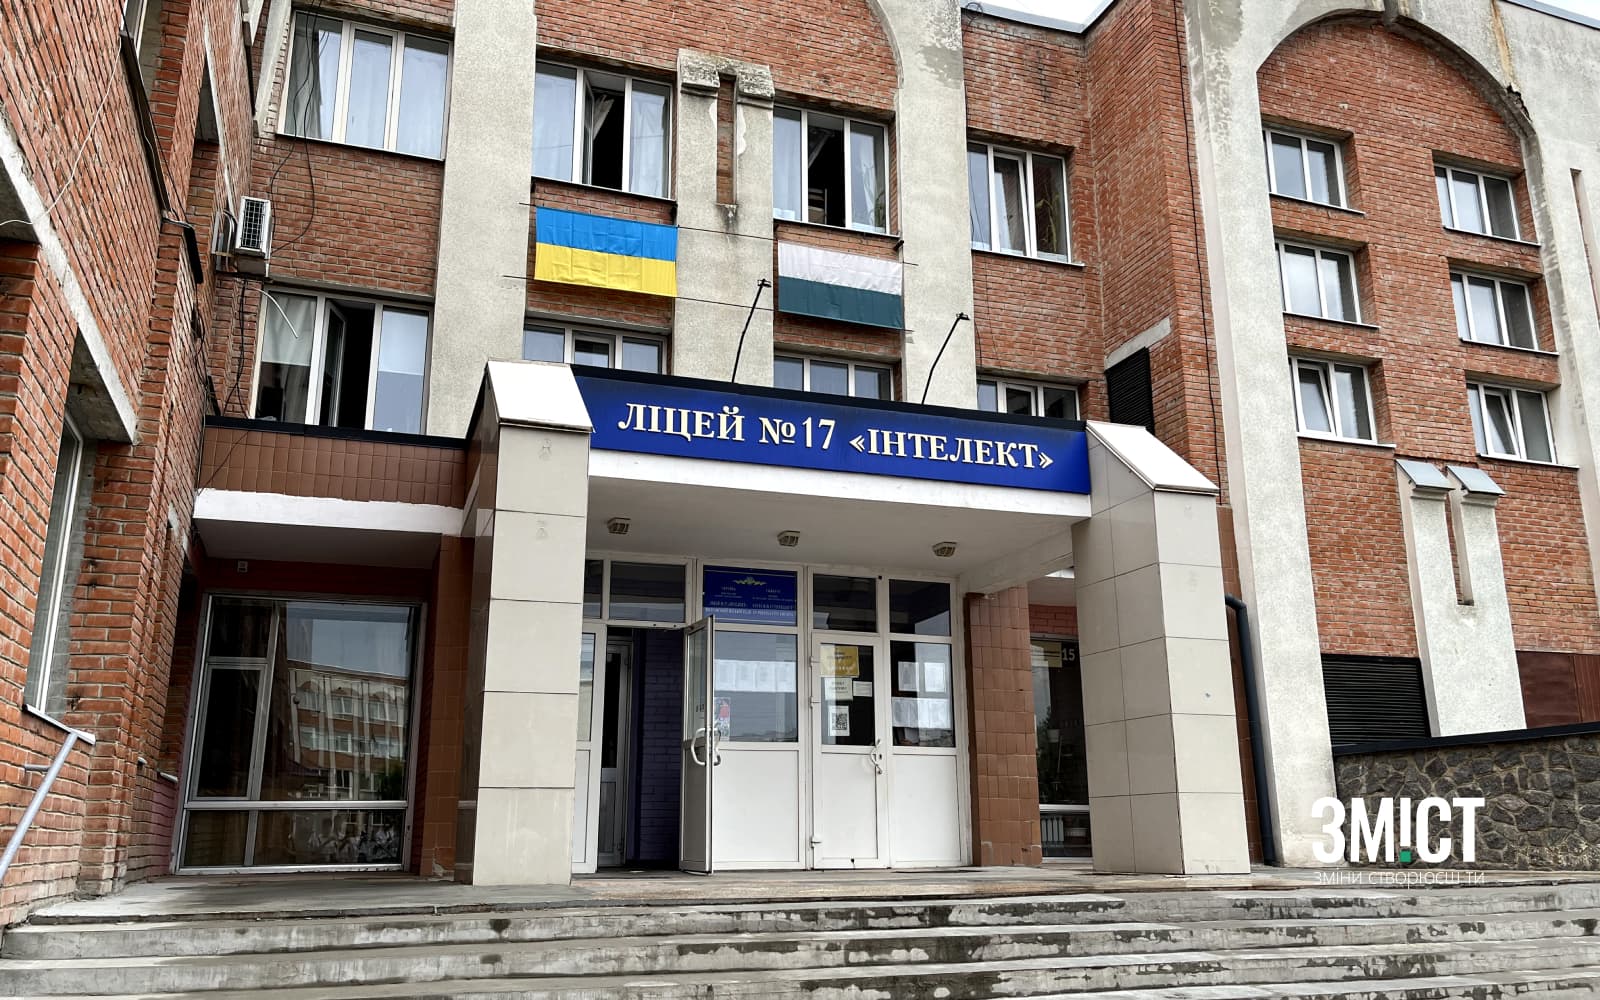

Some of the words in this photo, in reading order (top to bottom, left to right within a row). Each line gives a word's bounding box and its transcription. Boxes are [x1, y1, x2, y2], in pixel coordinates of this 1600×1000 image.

[617, 402, 745, 442] ЛІЦЕЙ
[849, 428, 1054, 469] «ІНТЕЛЕКТ»
[1062, 648, 1076, 661] 15
